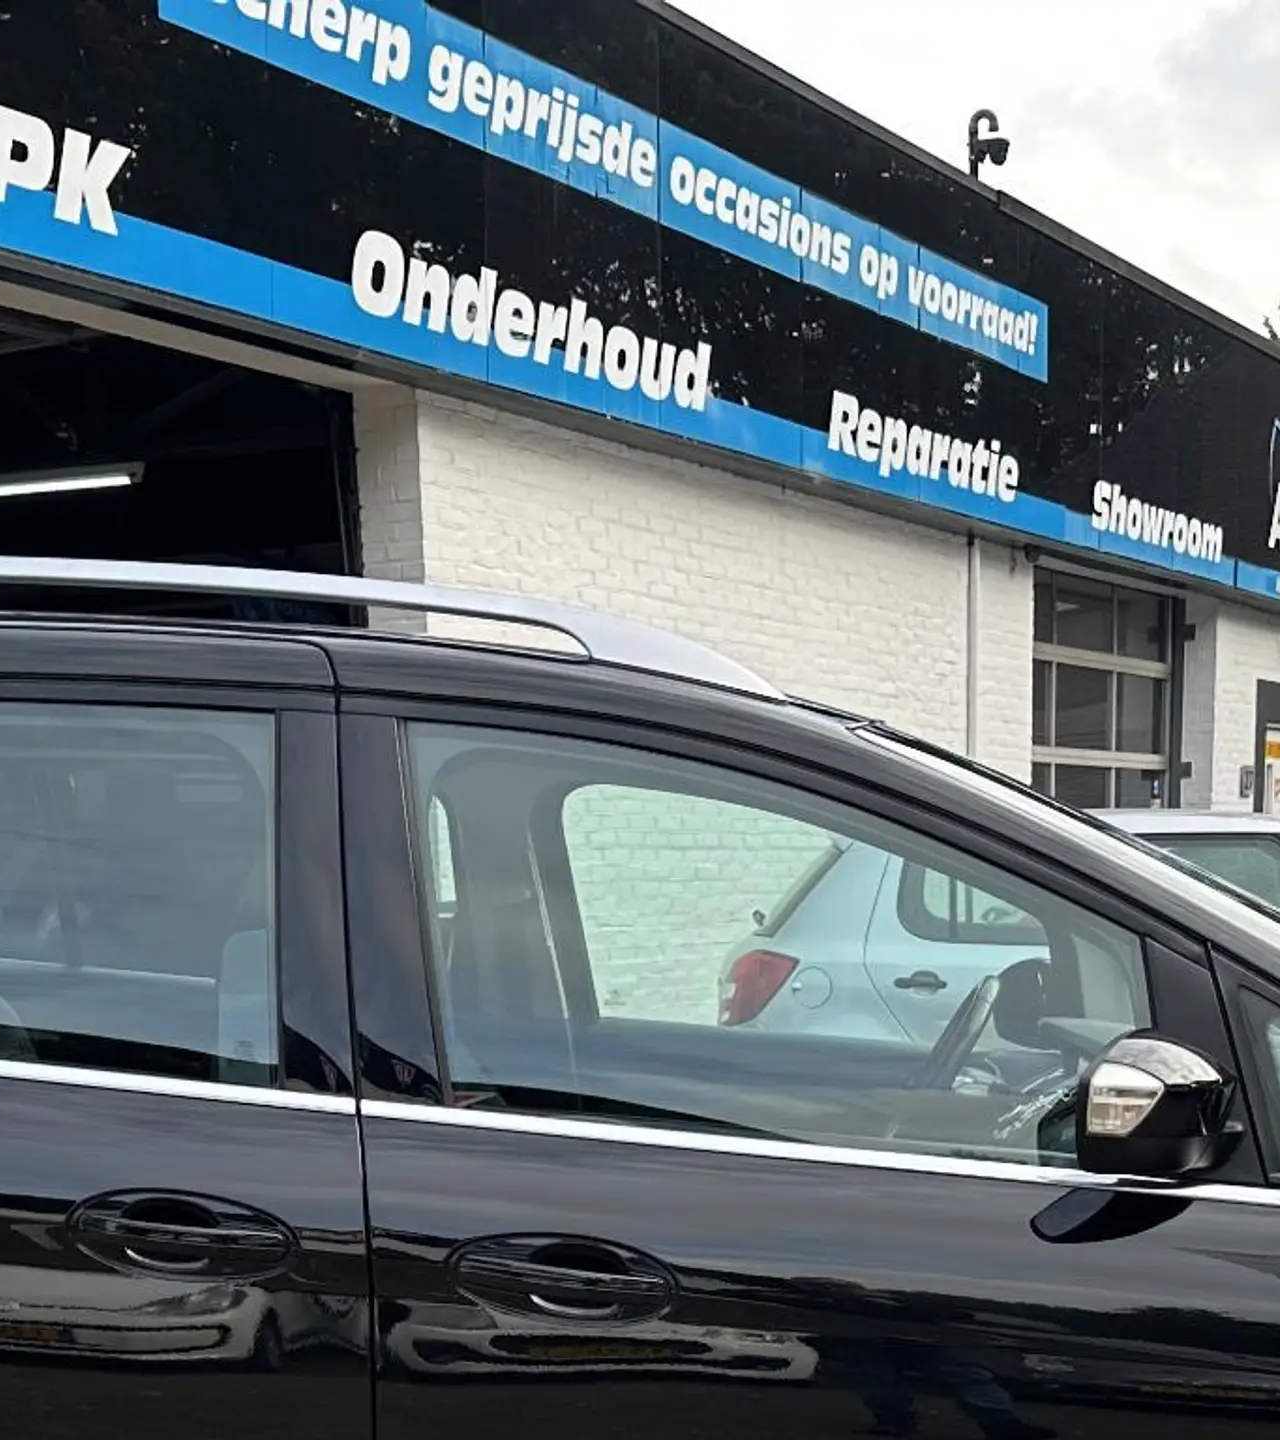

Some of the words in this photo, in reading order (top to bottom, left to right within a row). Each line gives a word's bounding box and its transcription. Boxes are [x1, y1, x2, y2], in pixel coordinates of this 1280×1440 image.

[211, 0, 411, 86] herp
[428, 44, 657, 188] geprijsde
[670, 155, 851, 275] occasions
[859, 244, 898, 300] op
[907, 264, 1038, 357] voorraad!
[351, 229, 712, 412] Onderhoud
[827, 389, 1019, 503] Reparatie
[1091, 479, 1224, 564] Showroom
